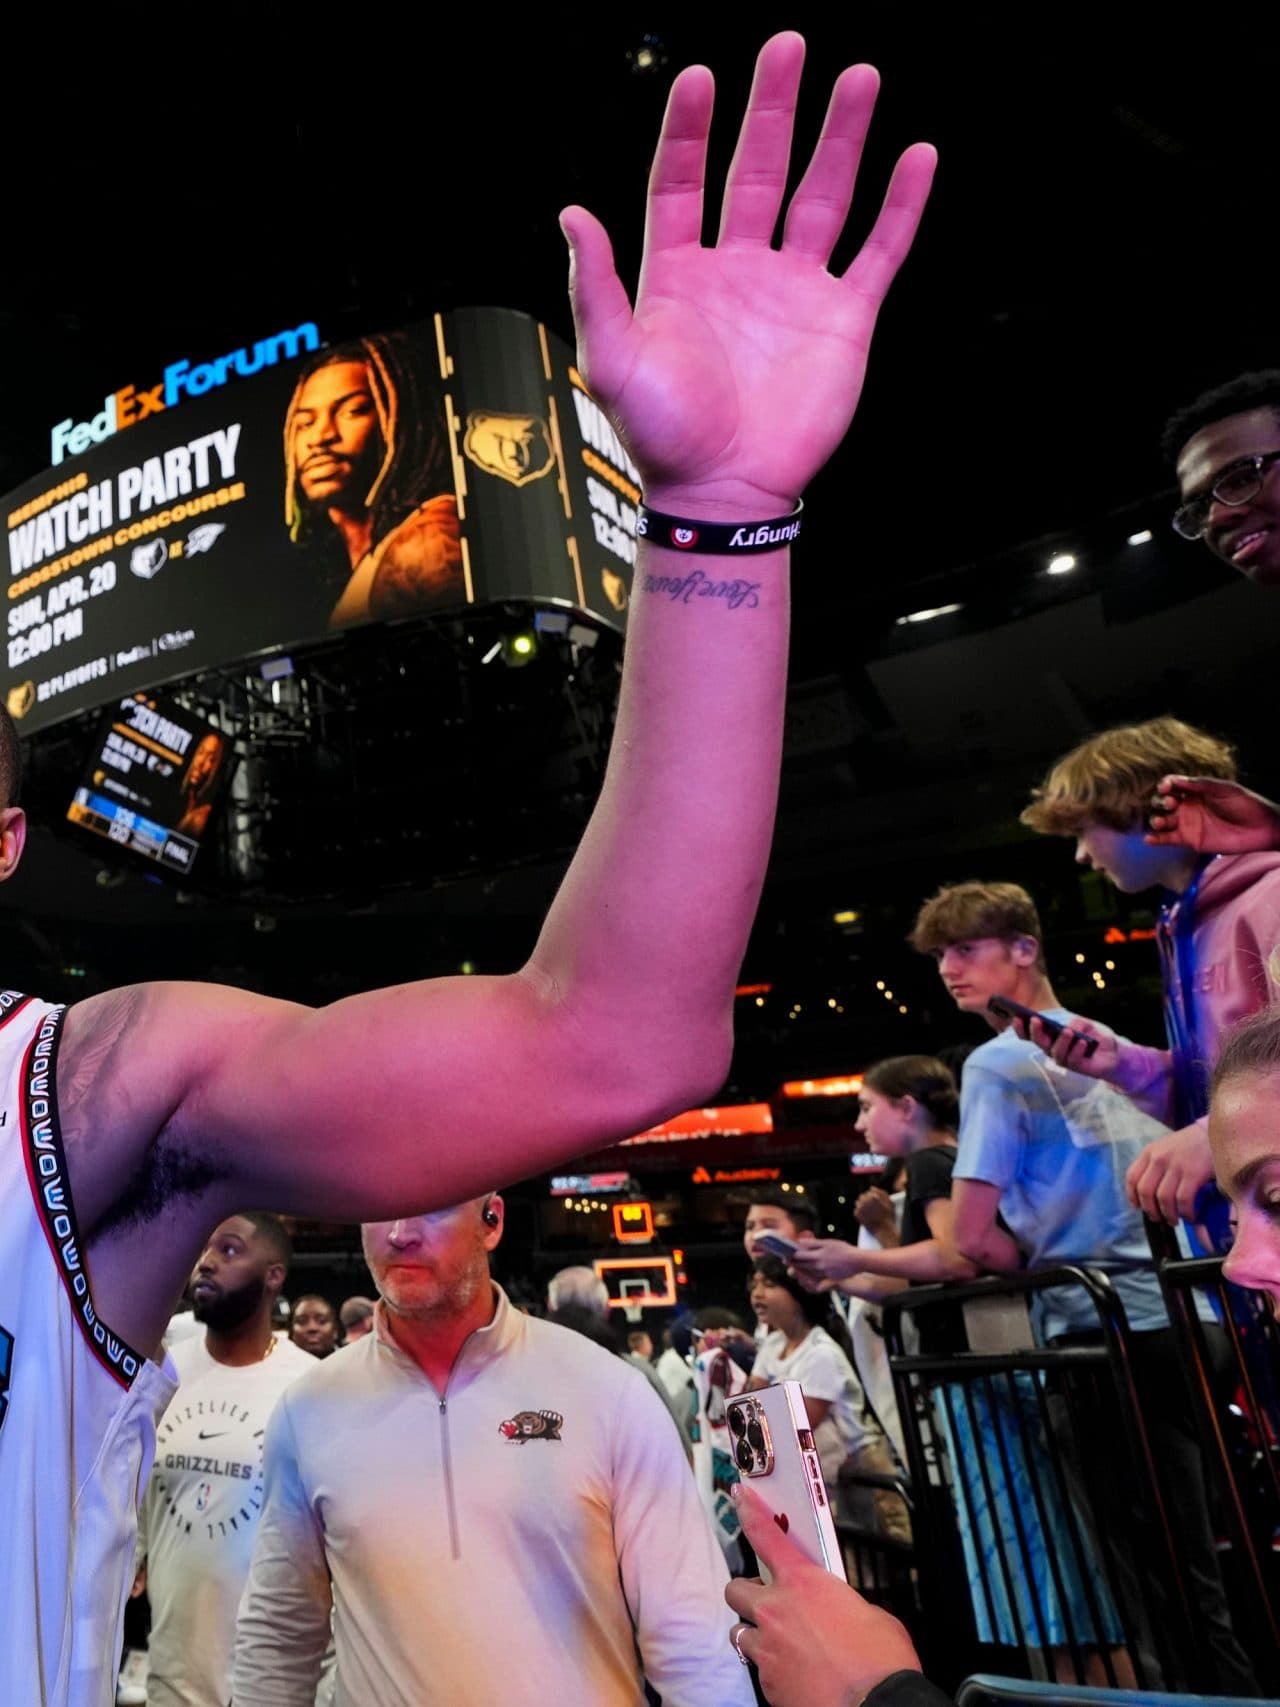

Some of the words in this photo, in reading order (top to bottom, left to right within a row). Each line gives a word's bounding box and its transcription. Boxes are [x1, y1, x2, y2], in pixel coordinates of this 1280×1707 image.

[51, 321, 319, 466] FedExForum
[8, 479, 113, 576] WATCH
[118, 423, 242, 520] PARTY
[7, 535, 114, 600] CROSSTOWN
[114, 482, 246, 546] CONCOURSE
[89, 560, 116, 597] 20
[53, 607, 83, 647] PM
[164, 1454, 253, 1480] GRIZZLIES
